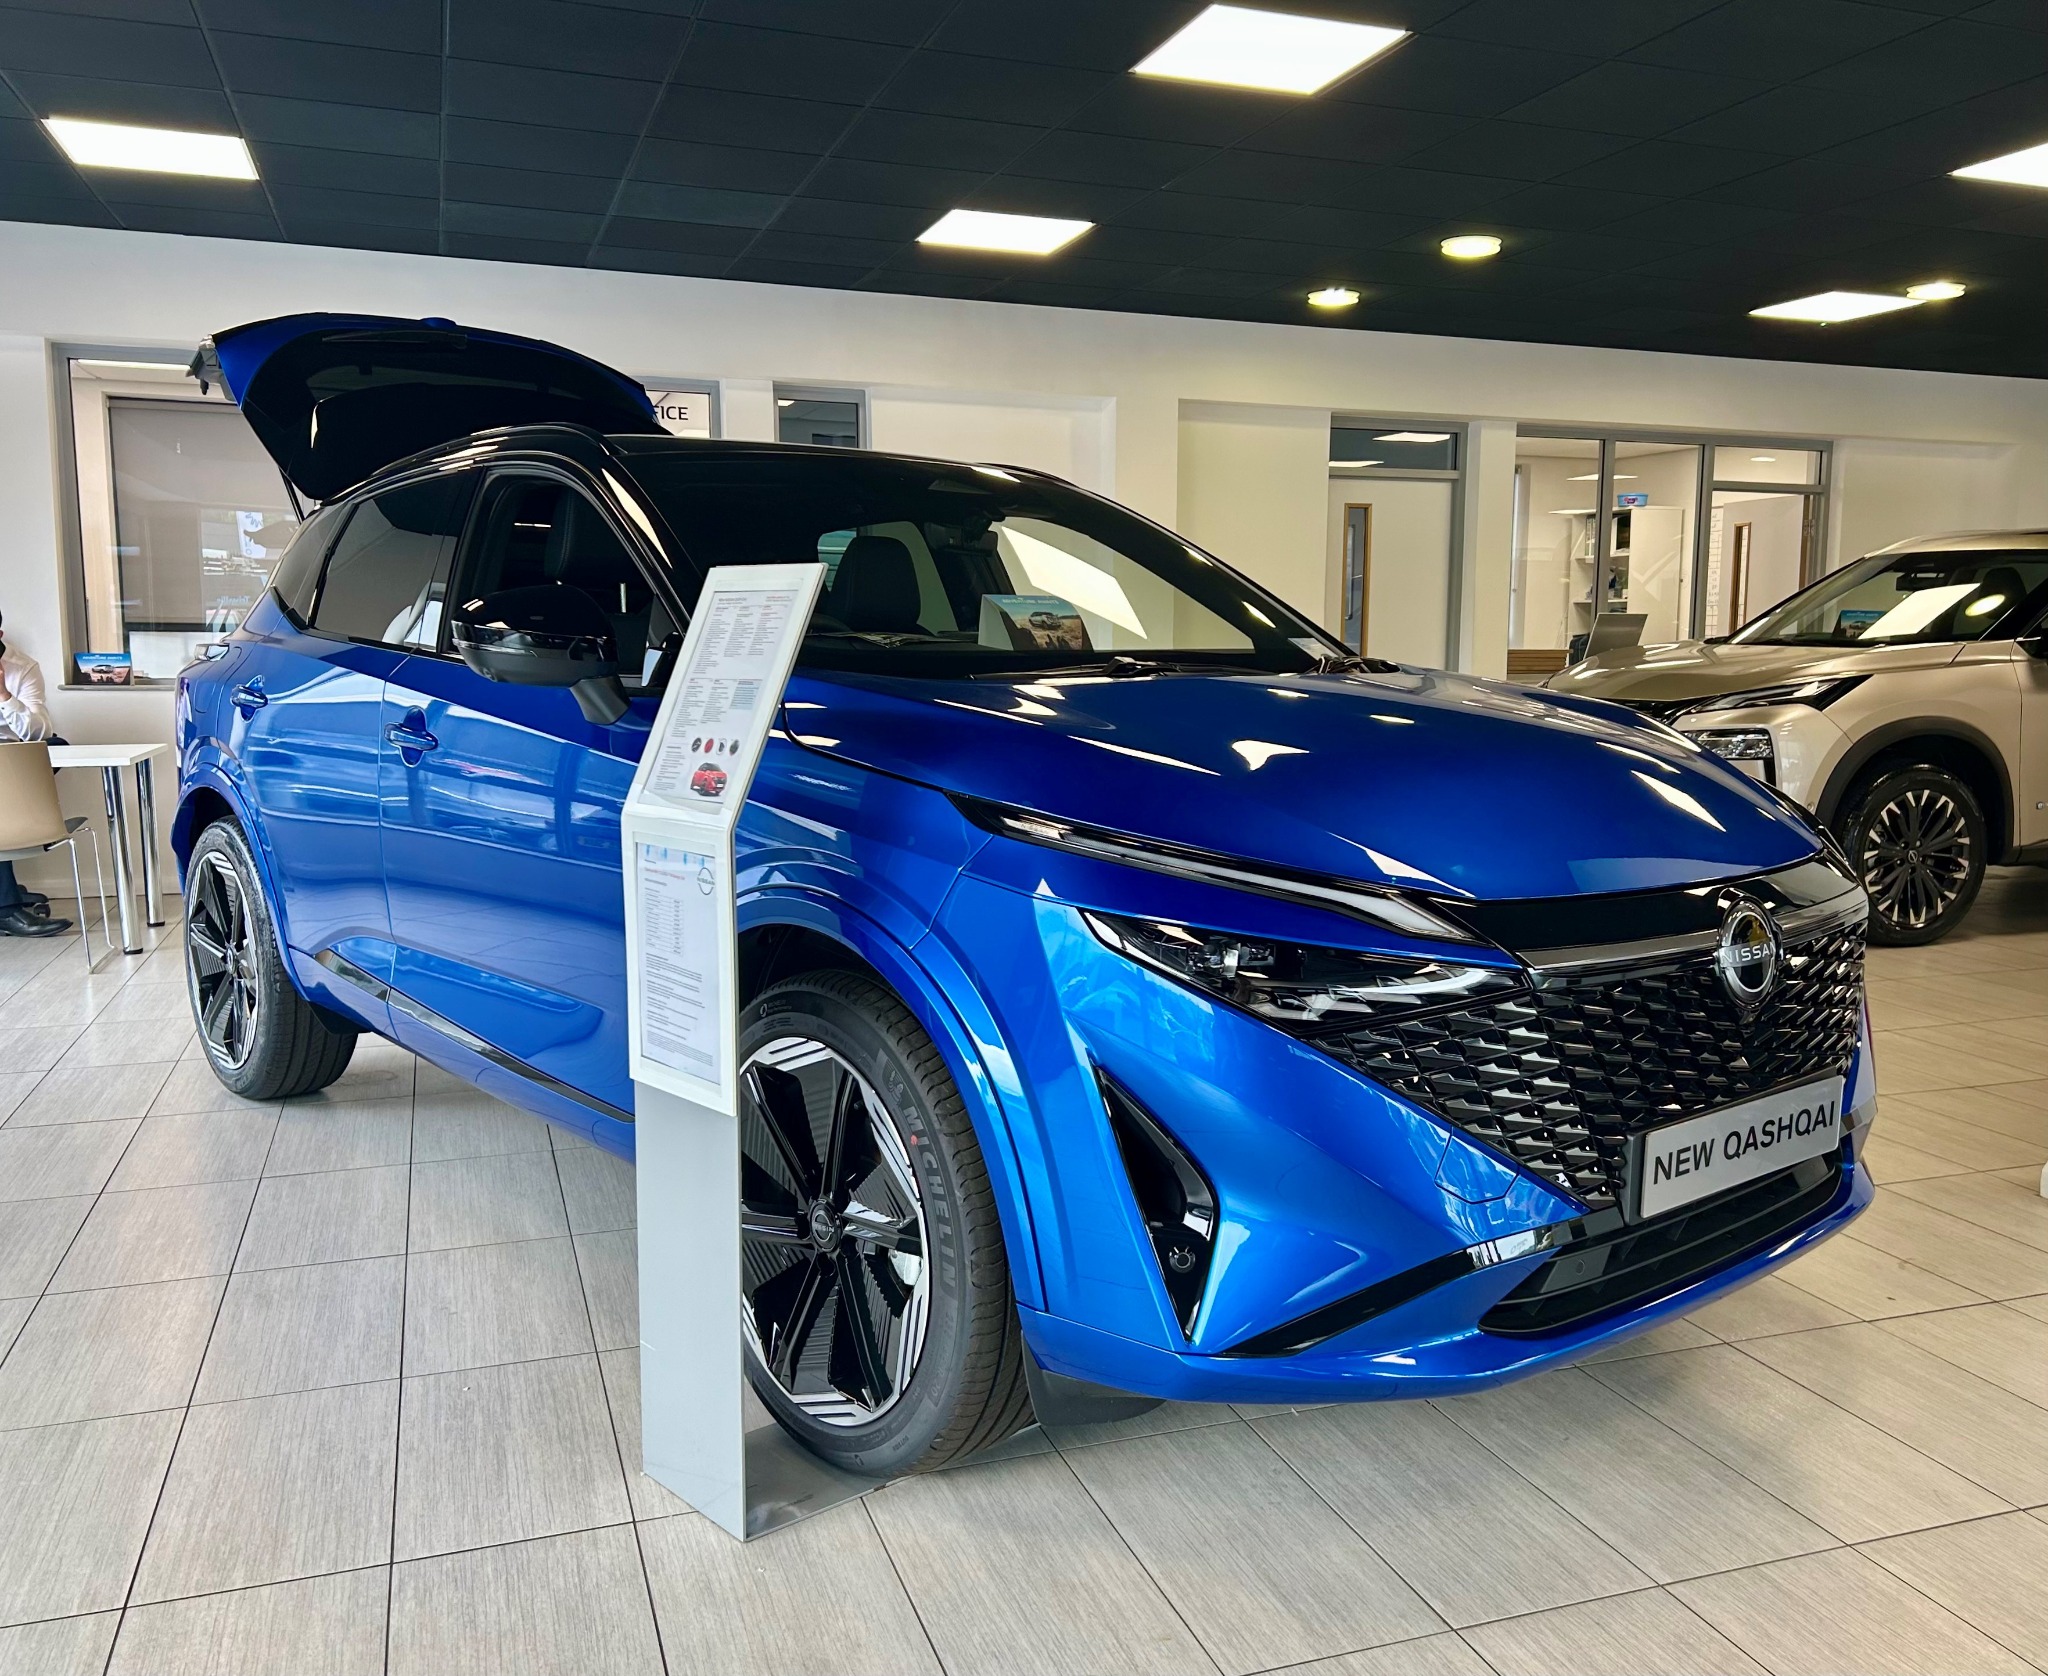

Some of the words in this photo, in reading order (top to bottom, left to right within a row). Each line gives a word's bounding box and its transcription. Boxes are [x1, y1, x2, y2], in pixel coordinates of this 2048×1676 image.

[1719, 941, 1776, 964] NISSAN
[1653, 1138, 1716, 1185] NEW
[1723, 1101, 1836, 1161] QASHQAI
[902, 1105, 957, 1289] MICHELIN
